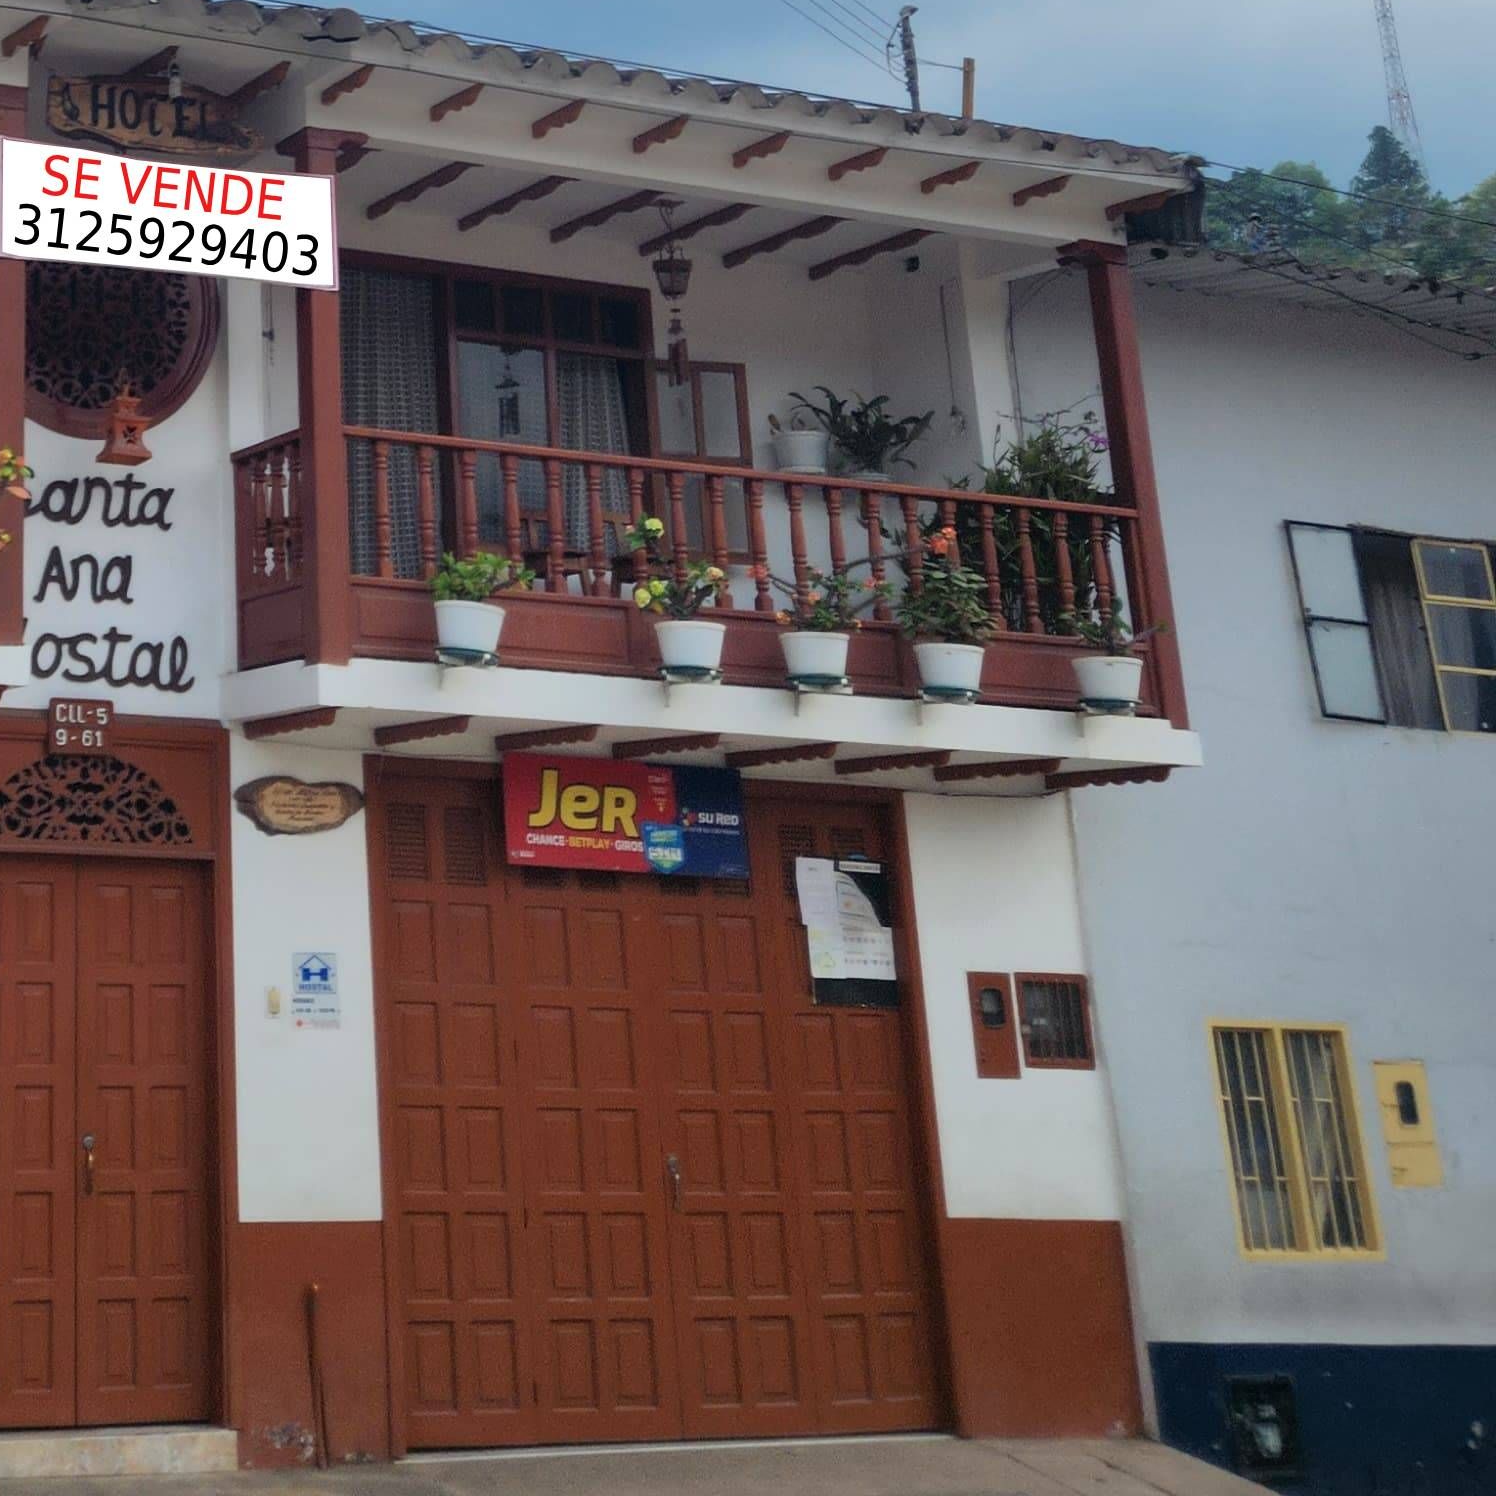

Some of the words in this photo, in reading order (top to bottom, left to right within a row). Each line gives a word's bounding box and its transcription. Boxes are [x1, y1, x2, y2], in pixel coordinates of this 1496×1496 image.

[90, 84, 226, 142] HOTEL
[24, 473, 175, 531] anta
[34, 546, 134, 604] Ana
[23, 618, 195, 693] ostal
[526, 833, 566, 847] CHANCE
[569, 836, 610, 850] BETPLAY
[615, 839, 644, 852] GIROS
